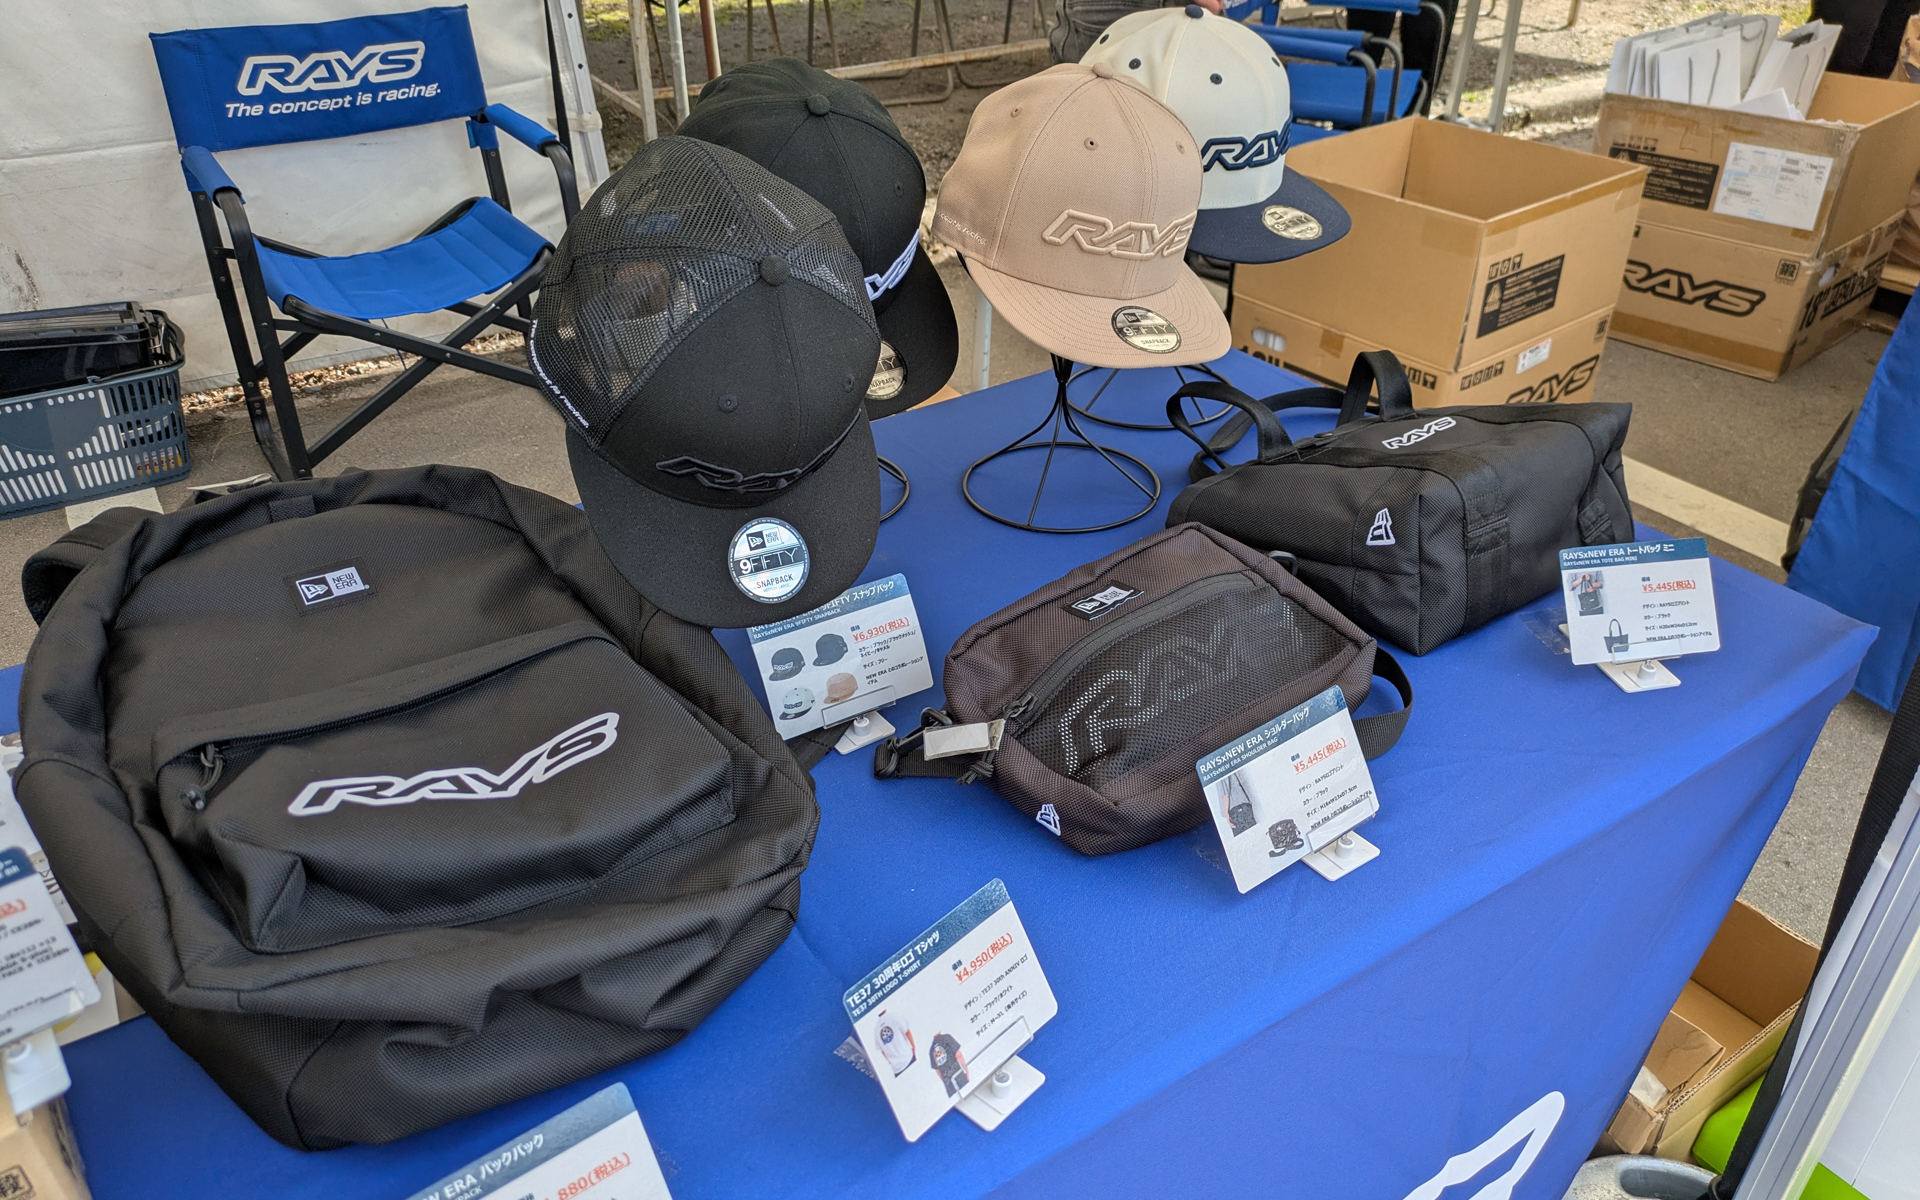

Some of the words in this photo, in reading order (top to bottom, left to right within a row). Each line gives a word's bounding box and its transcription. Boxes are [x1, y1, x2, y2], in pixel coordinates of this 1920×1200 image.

[237, 40, 426, 96] RAYS
[225, 103, 264, 118] The
[268, 94, 352, 115] concept
[356, 91, 372, 106] is
[377, 82, 441, 102] racing.
[1201, 111, 1293, 172] RAY
[1622, 258, 1767, 318] RAYS
[1382, 416, 1457, 450] RAYS
[740, 548, 797, 574] 9FIFTY
[1562, 549, 1606, 560] RAYSxNEW
[1609, 549, 1625, 557] ERA
[1627, 544, 1661, 556] トートバッグ
[1663, 543, 1675, 552] ミニ
[1563, 559, 1590, 567] RAYSxNEW
[332, 572, 354, 584] NEW
[335, 579, 358, 590] ERA
[756, 573, 794, 588] SNAPBACK
[853, 580, 894, 601] スナップバック
[1642, 579, 1696, 592] ¥5,445(税込)
[814, 607, 842, 621] SNAPBACK
[853, 617, 910, 642] ¥6,930(税込)
[1199, 744, 1245, 774] RAYSxNEW
[1246, 734, 1264, 748] ERA
[1264, 707, 1310, 739] ショルダーバッグ
[1293, 737, 1347, 773] ¥5,445(税込)
[287, 712, 620, 816] RAYS
[1203, 765, 1230, 782] RAYSxNEW
[1230, 757, 1241, 768] ERA
[1241, 744, 1268, 762] SHOULDER
[1267, 737, 1278, 747] BAG
[846, 983, 871, 1008] TE37
[872, 947, 915, 990] 30周年ロゴ
[914, 930, 940, 955] Tシャツ
[951, 959, 963, 971] 価格
[955, 932, 1014, 983] ¥4,950(税込)
[1004, 960, 1021, 977] ANNIV
[852, 1001, 867, 1017] TE37
[867, 992, 883, 1006] 30TH
[882, 978, 899, 994] LOGO
[897, 960, 921, 981] T-SHIRT
[444, 1173, 477, 1198] ERA
[480, 1133, 544, 1180] バックパック
